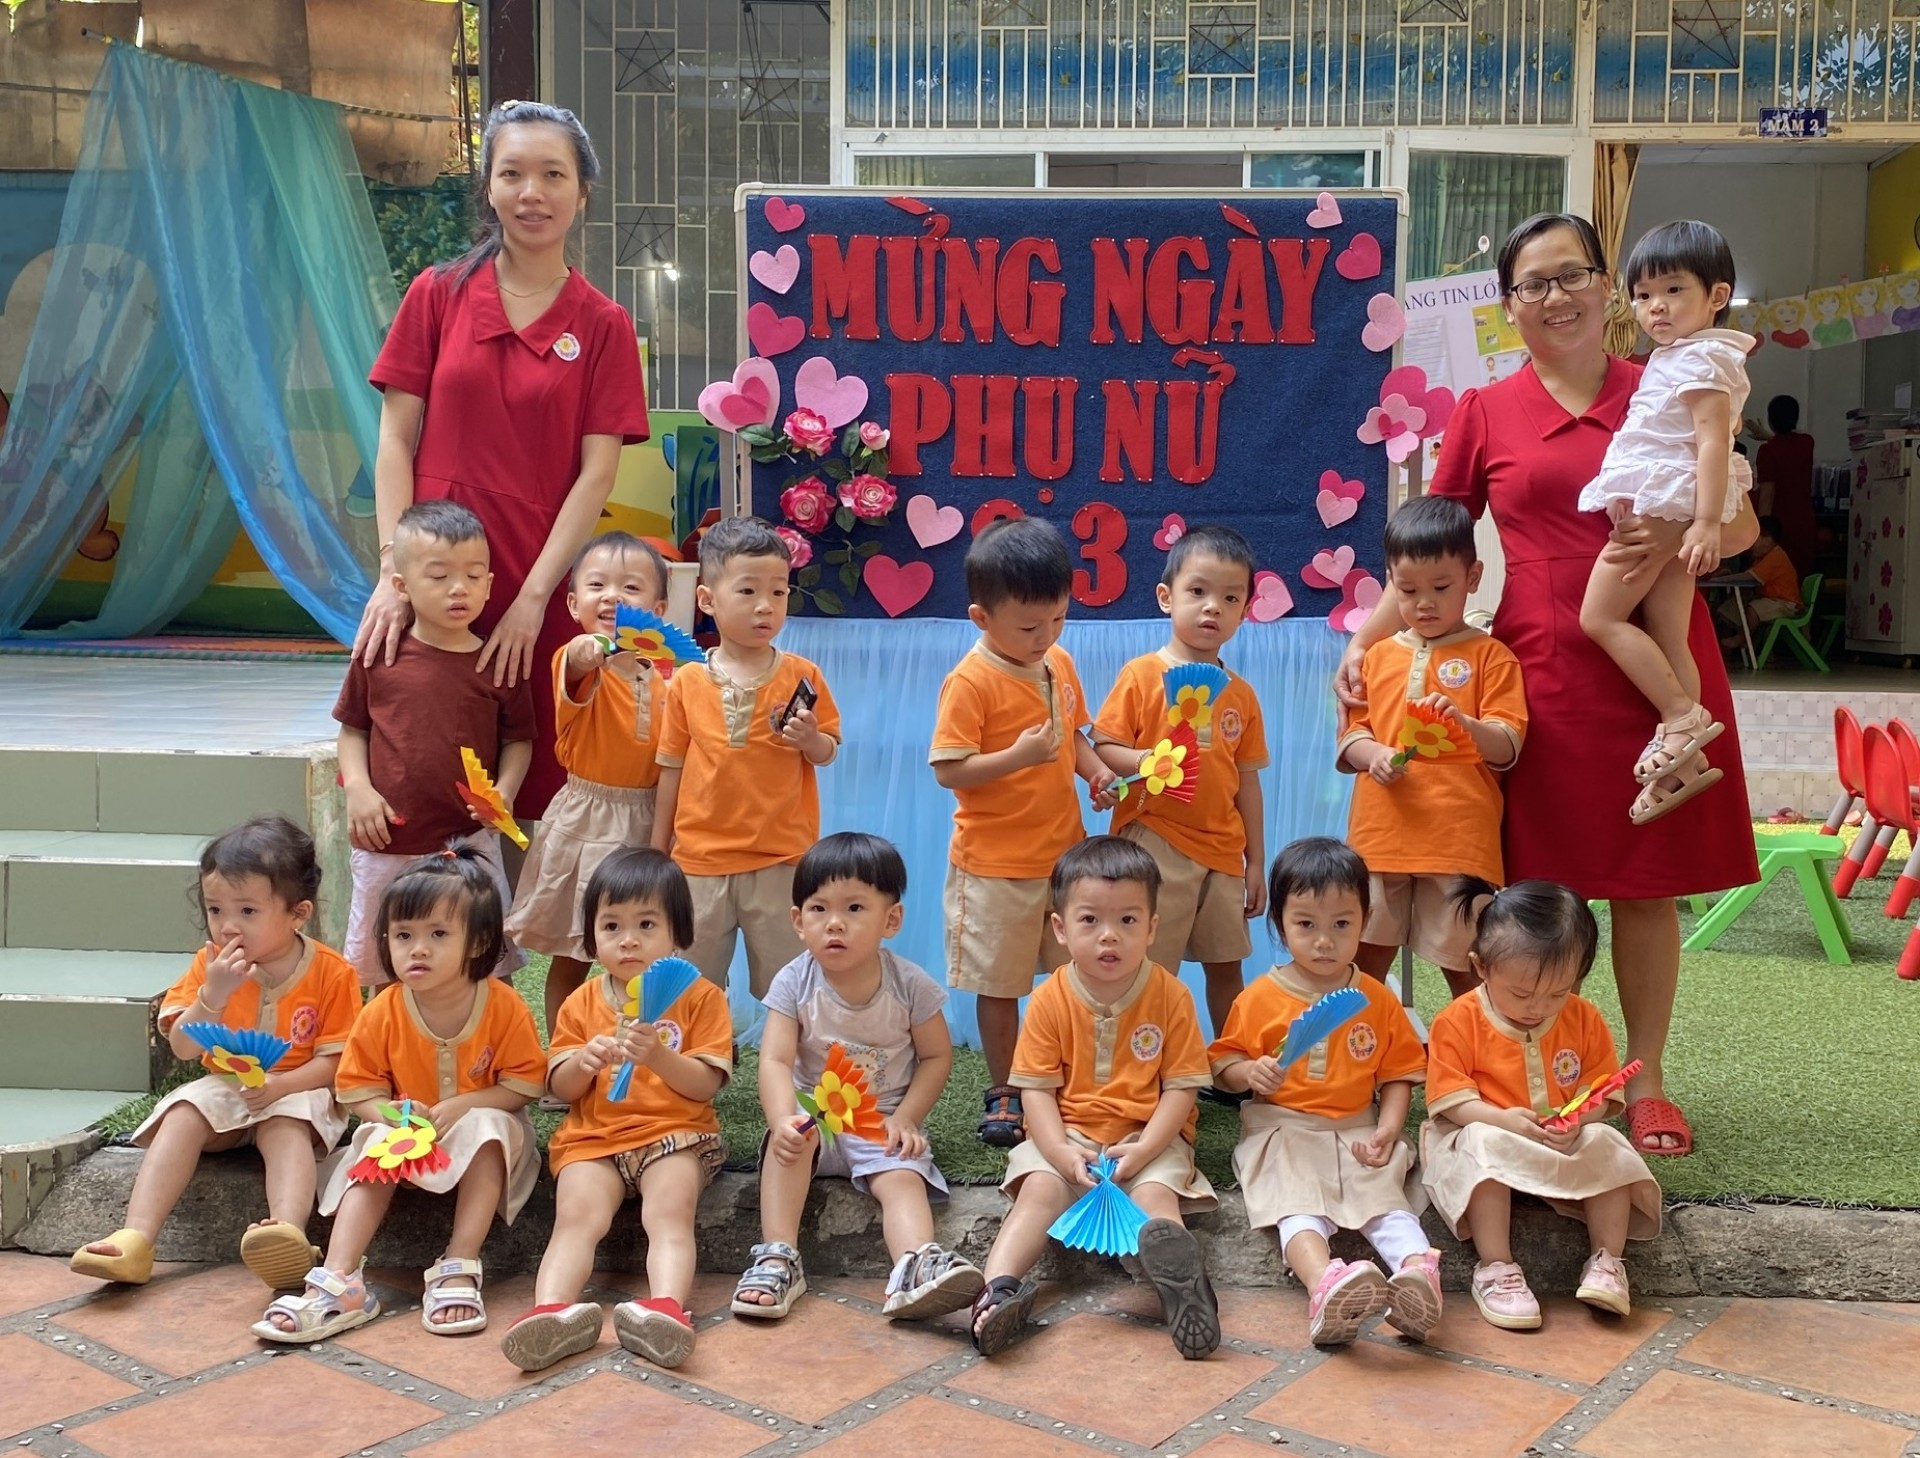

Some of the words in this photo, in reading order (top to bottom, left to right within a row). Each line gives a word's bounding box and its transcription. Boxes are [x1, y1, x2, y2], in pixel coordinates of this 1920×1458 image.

[1810, 119, 1820, 132] 2
[807, 196, 1066, 348] MỪNG
[1090, 201, 1332, 346] NGÀY
[1440, 286, 1470, 305] TIN
[885, 372, 1079, 503] PHỤ
[1100, 347, 1236, 485] NỮ
